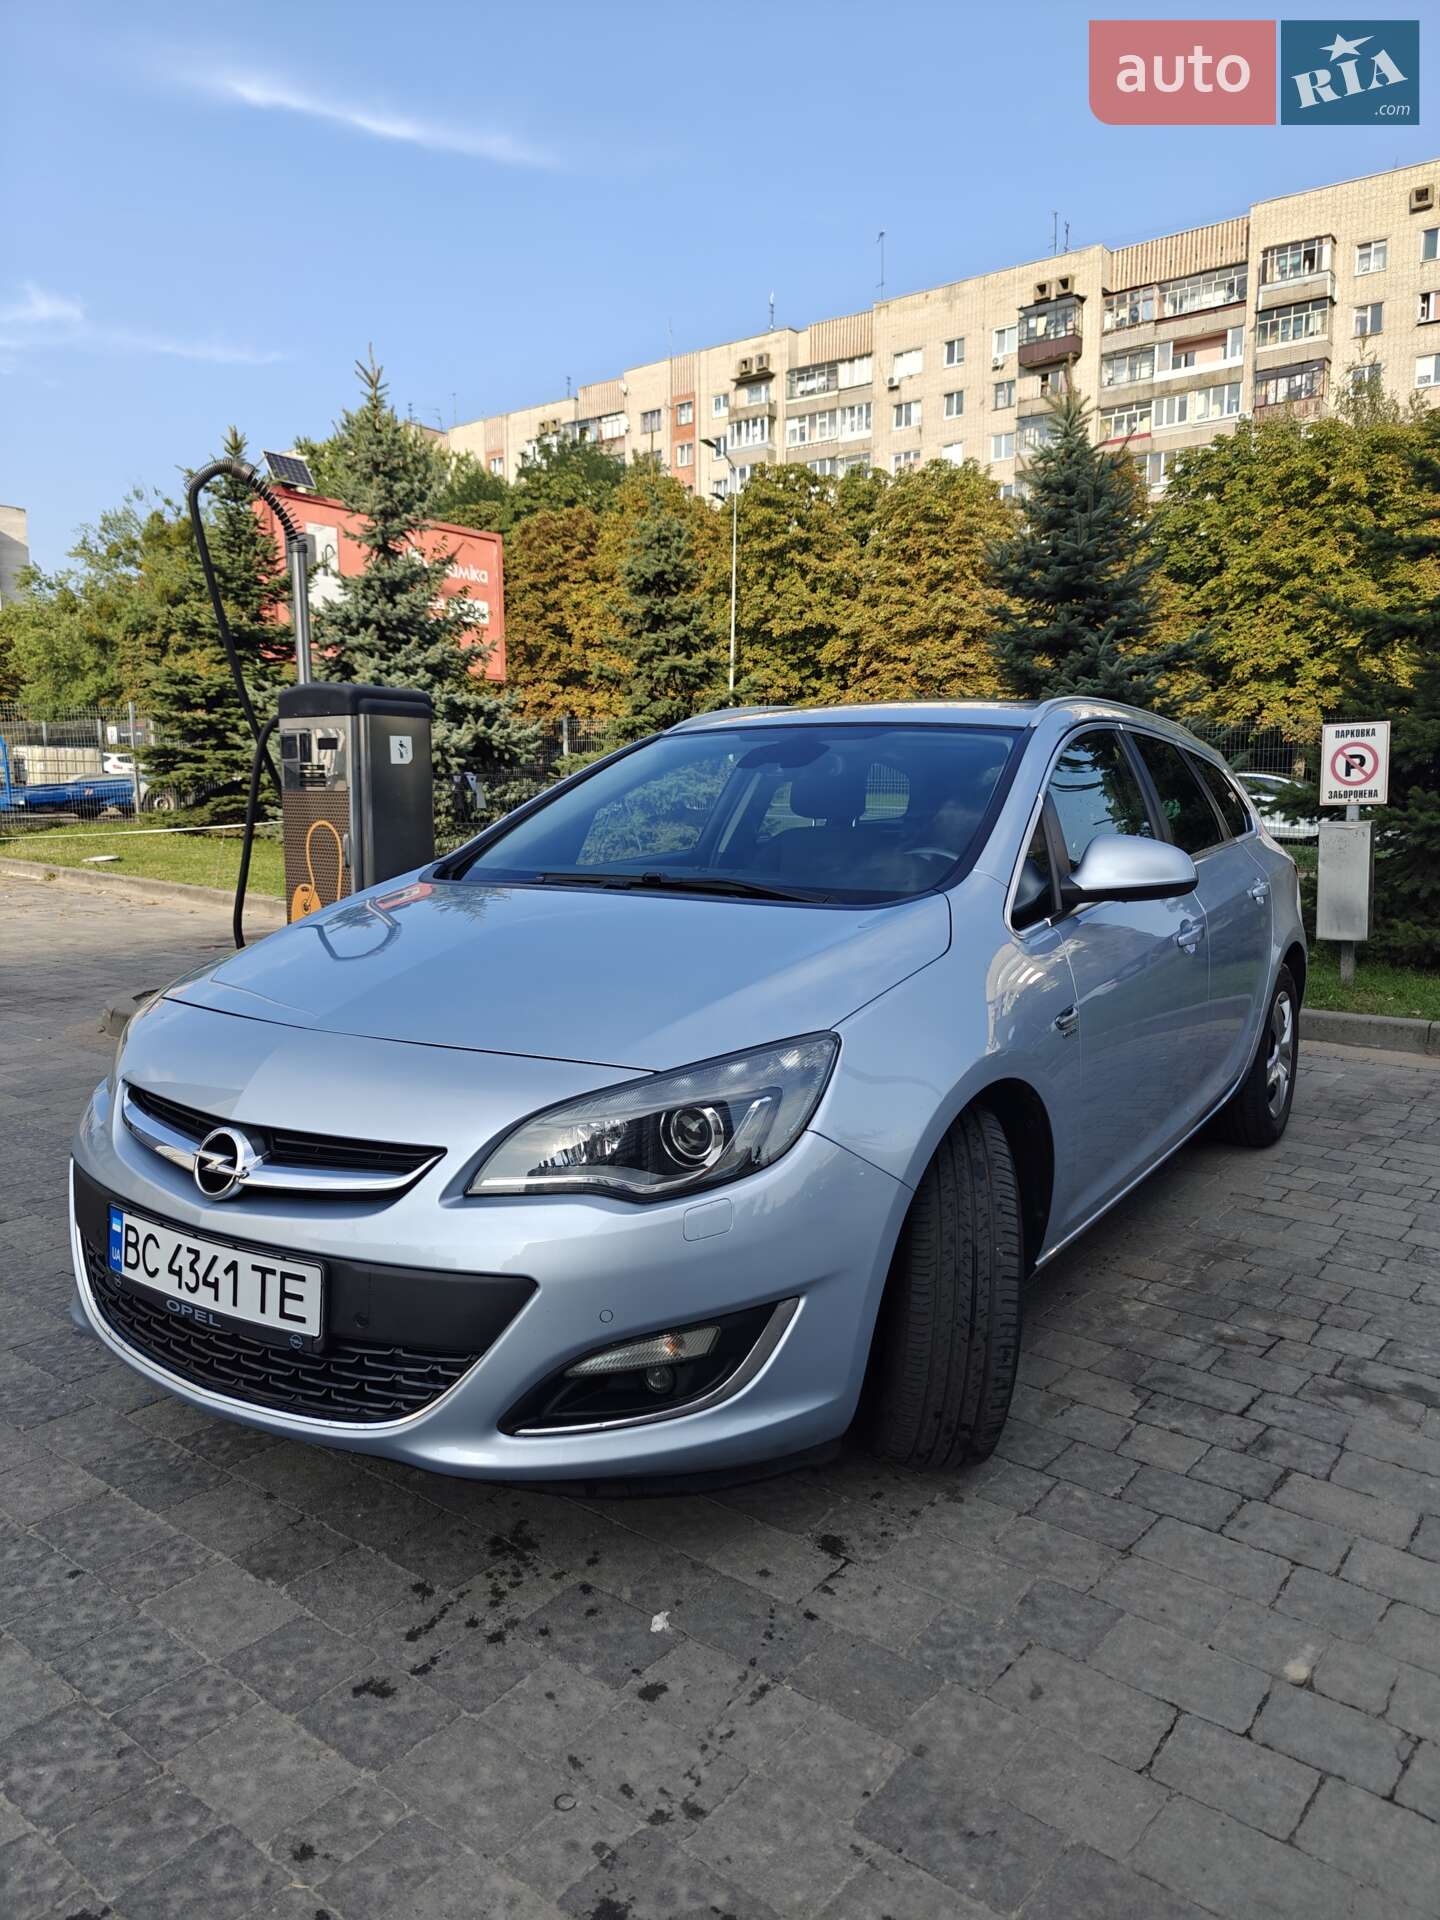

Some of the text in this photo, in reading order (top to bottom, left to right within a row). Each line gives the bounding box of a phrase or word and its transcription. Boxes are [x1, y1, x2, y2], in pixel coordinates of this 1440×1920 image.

[1335, 728, 1376, 739] ПАРКОВКА
[1328, 789, 1378, 799] ЗАБОРОНЕНА
[111, 1247, 121, 1262] UA
[124, 1223, 306, 1324] BC 4341 TE
[166, 1299, 221, 1328] OPEL
